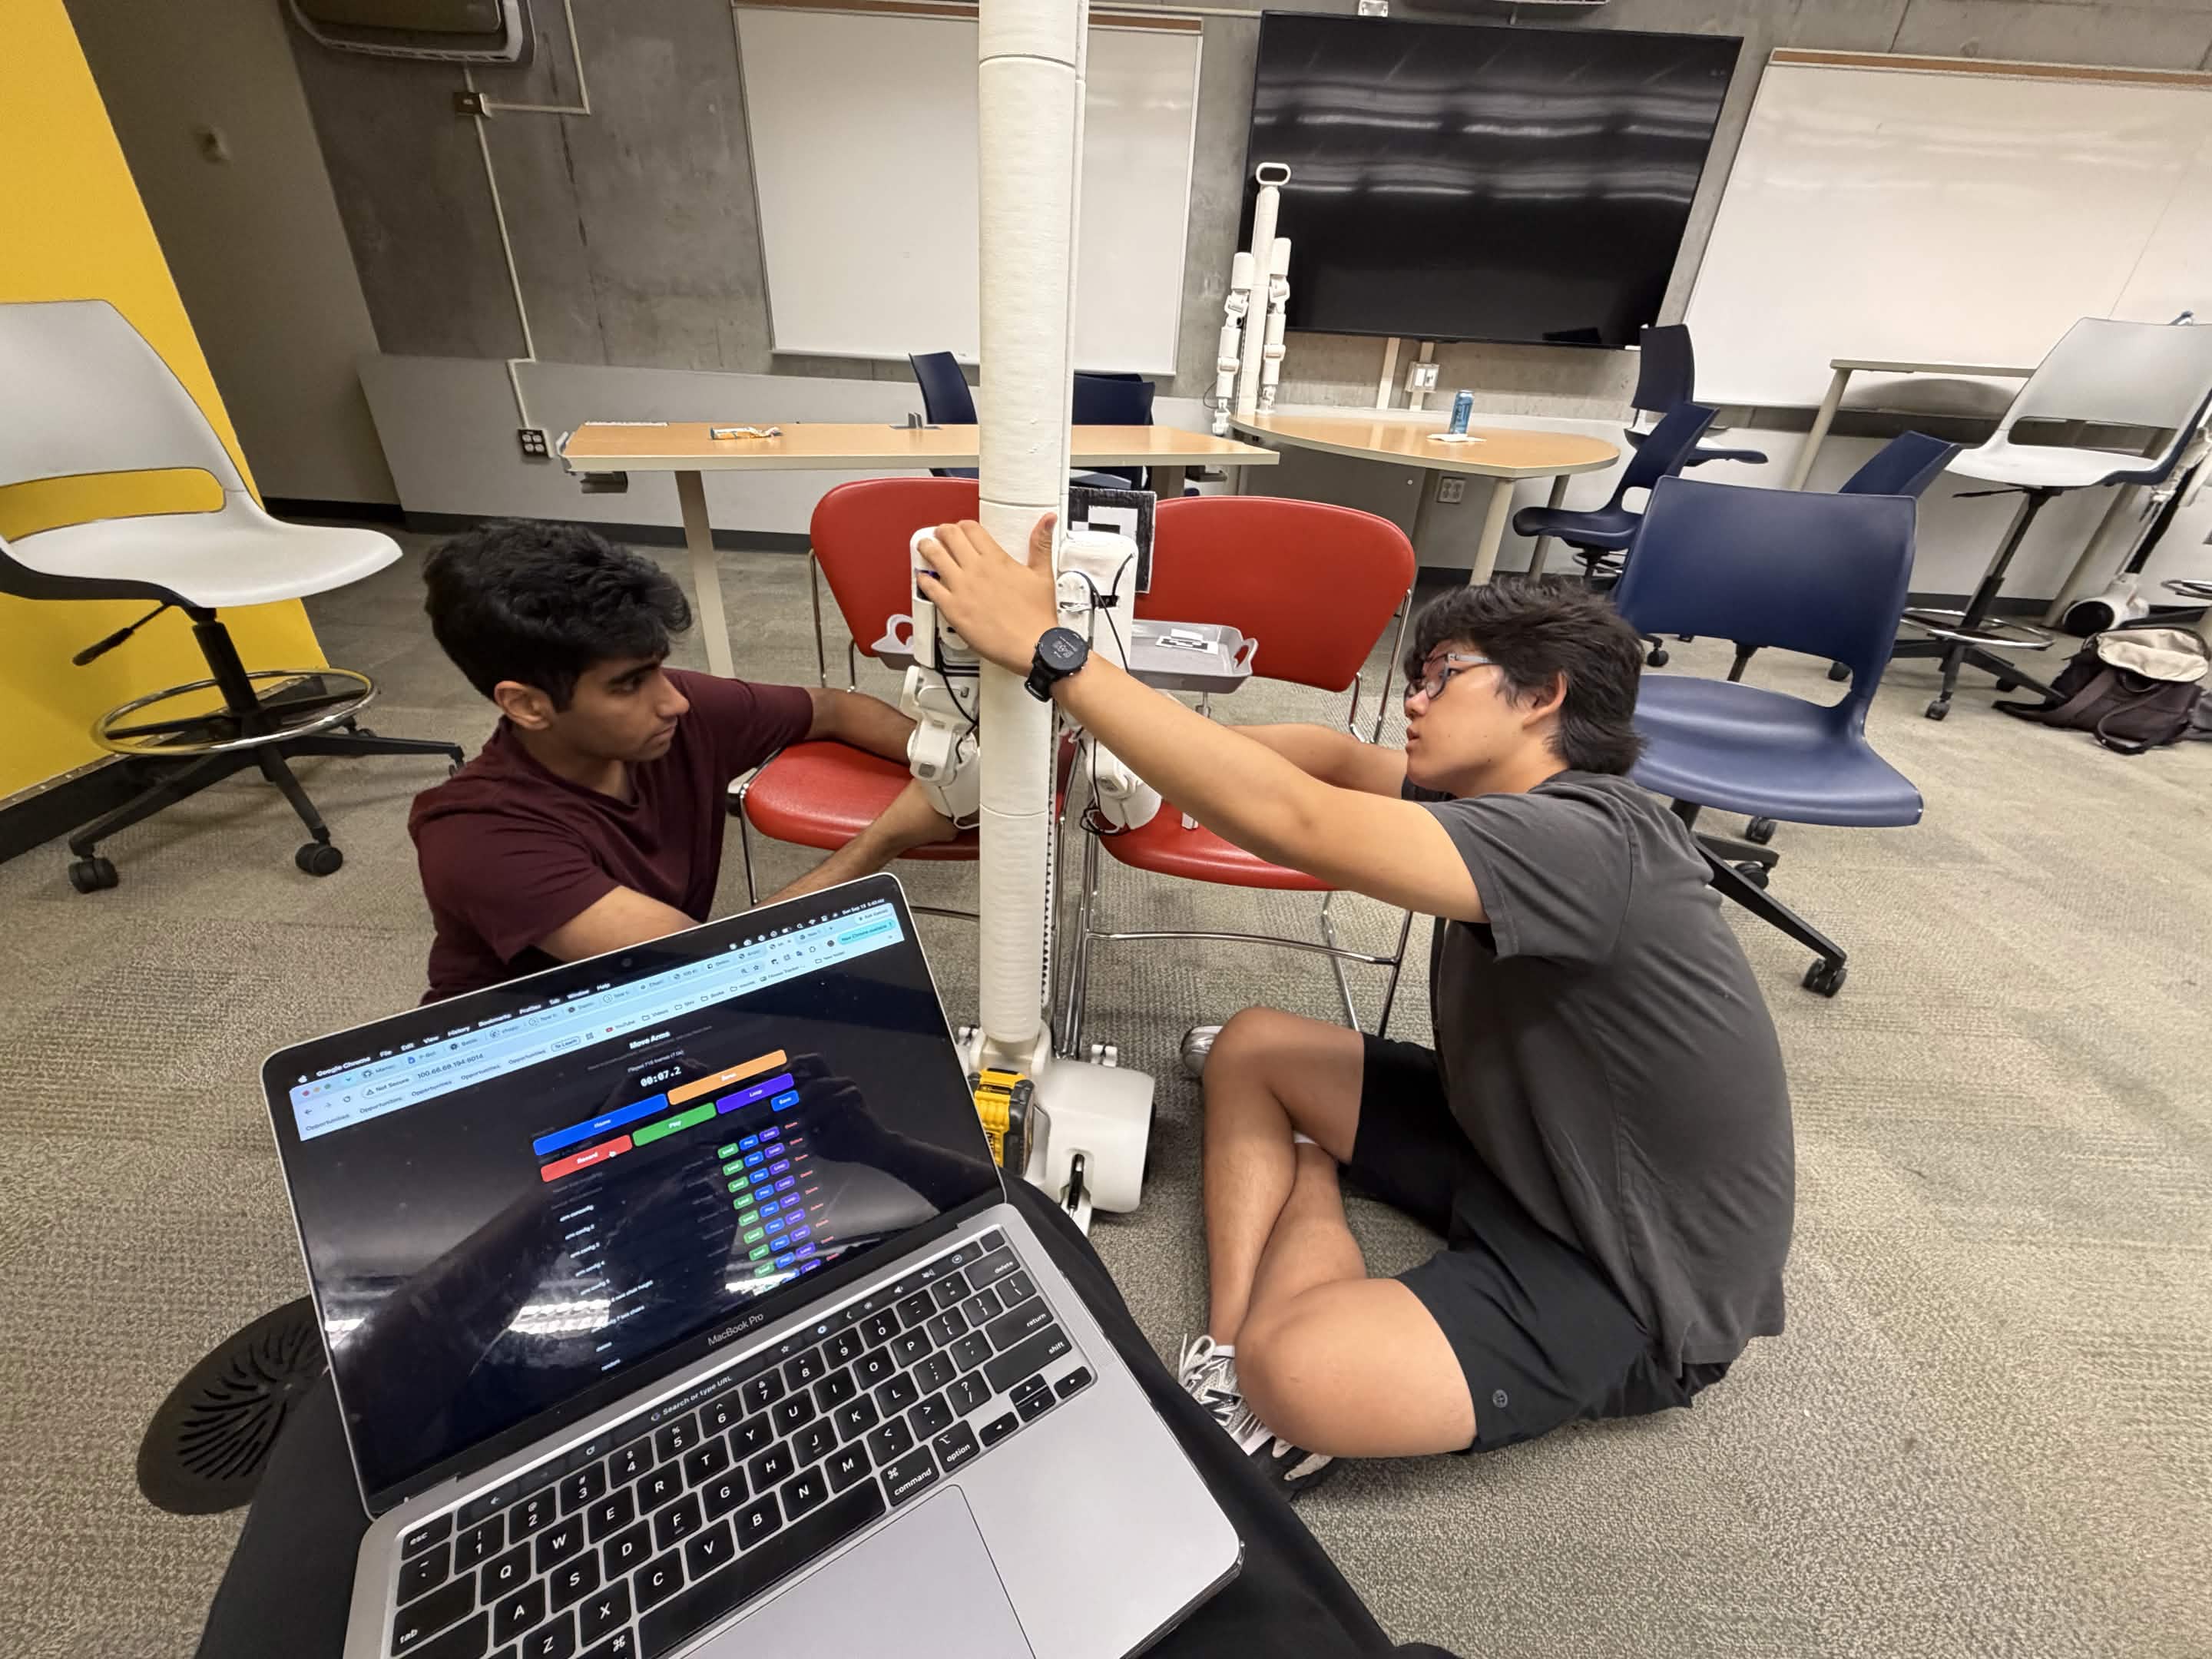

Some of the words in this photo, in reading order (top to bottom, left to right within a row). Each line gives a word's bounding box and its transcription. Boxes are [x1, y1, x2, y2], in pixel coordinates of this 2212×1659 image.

[596, 982, 611, 992] Help
[567, 989, 591, 1001] Window
[447, 1025, 471, 1038] History
[401, 1042, 415, 1051] Edit
[423, 1035, 439, 1045] View
[629, 1036, 650, 1049] Move
[651, 1031, 671, 1043] Arms
[379, 1049, 393, 1058] File
[316, 1064, 343, 1077] Google
[343, 1055, 371, 1070] Chrome
[641, 1066, 682, 1088] 00:07.2
[376, 1083, 387, 1093] Not
[388, 1077, 410, 1089] Secure
[359, 1096, 402, 1114] Opportunities
[411, 1079, 453, 1097] Opportunities
[577, 1151, 598, 1164] Record
[995, 1260, 1014, 1273] delete
[1026, 1313, 1046, 1328] return
[707, 1320, 749, 1346] MacBook
[749, 1313, 764, 1326] Pro
[907, 1341, 915, 1352] P
[1048, 1341, 1065, 1355] shift
[869, 1362, 879, 1373] O
[663, 1396, 690, 1416] Search
[690, 1391, 700, 1400] or
[700, 1383, 717, 1398] type
[717, 1375, 733, 1387] URL
[892, 1389, 901, 1399] L
[717, 1412, 726, 1423] 6
[788, 1406, 798, 1418] U
[851, 1411, 861, 1423] K
[674, 1435, 682, 1448] 5
[746, 1429, 755, 1441] Y
[701, 1453, 710, 1467] T
[946, 1443, 971, 1463] option
[627, 1462, 636, 1473] 4
[766, 1460, 776, 1472] H
[841, 1458, 855, 1472] M
[654, 1480, 665, 1493] R
[894, 1468, 932, 1496] command
[579, 1487, 588, 1499] 3
[720, 1486, 730, 1498] G
[798, 1485, 810, 1498] N
[528, 1514, 538, 1527] 2
[606, 1507, 615, 1521] E
[752, 1512, 763, 1527] B
[409, 1533, 428, 1545] esc
[551, 1533, 567, 1549] W
[621, 1542, 632, 1556] D
[704, 1541, 714, 1555] V
[499, 1565, 512, 1580] Q
[569, 1572, 580, 1587] S
[653, 1572, 664, 1587] C
[513, 1604, 525, 1621] A
[599, 1601, 611, 1620] X
[399, 1628, 418, 1644] tab
[543, 1636, 554, 1654] Z
